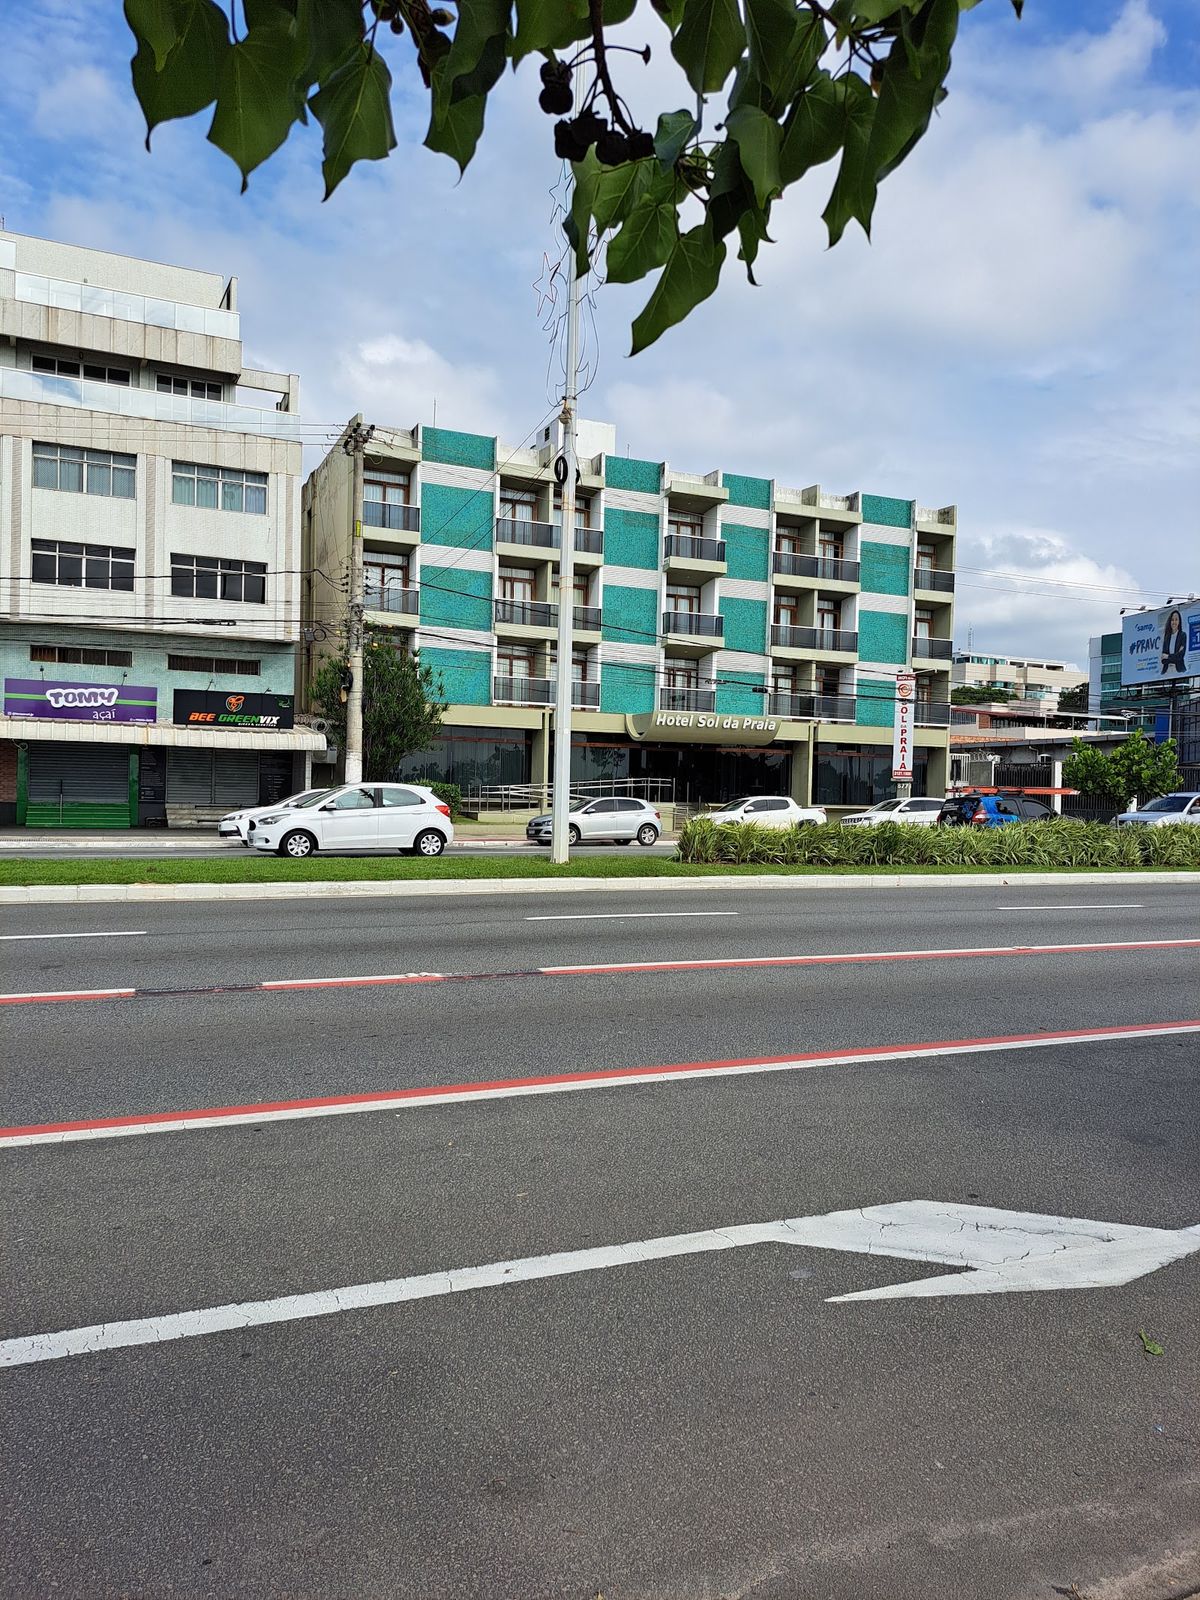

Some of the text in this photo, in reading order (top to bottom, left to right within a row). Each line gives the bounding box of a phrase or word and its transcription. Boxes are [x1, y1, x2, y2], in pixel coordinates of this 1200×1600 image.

[48, 690, 116, 706] TOMY
[92, 708, 117, 720] açaí
[189, 712, 281, 725] BEE GREENVIX
[655, 713, 777, 731] Hotel Sol da Praia
